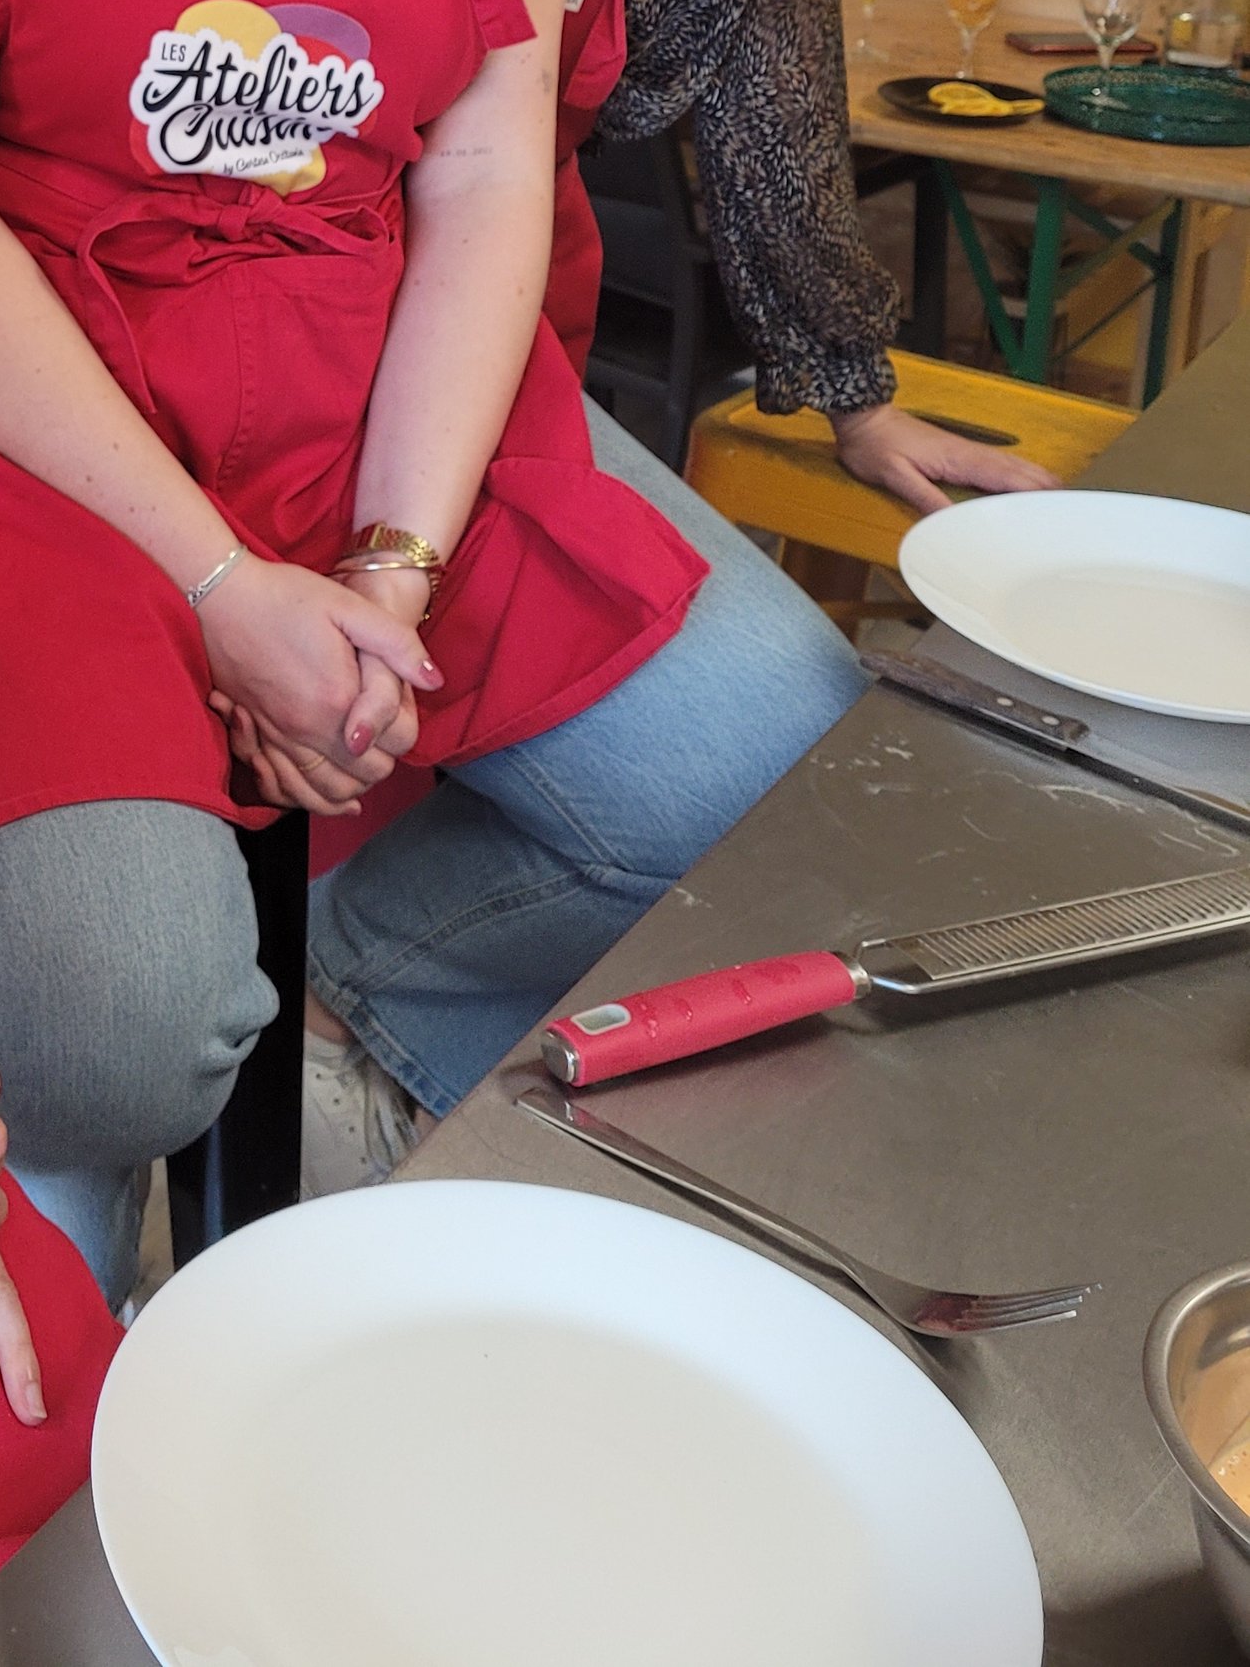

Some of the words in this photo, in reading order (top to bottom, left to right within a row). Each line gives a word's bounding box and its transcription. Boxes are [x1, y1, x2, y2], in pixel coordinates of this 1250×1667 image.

[161, 42, 187, 63] LES
[142, 40, 375, 118] Ateliers
[223, 163, 234, 175] by
